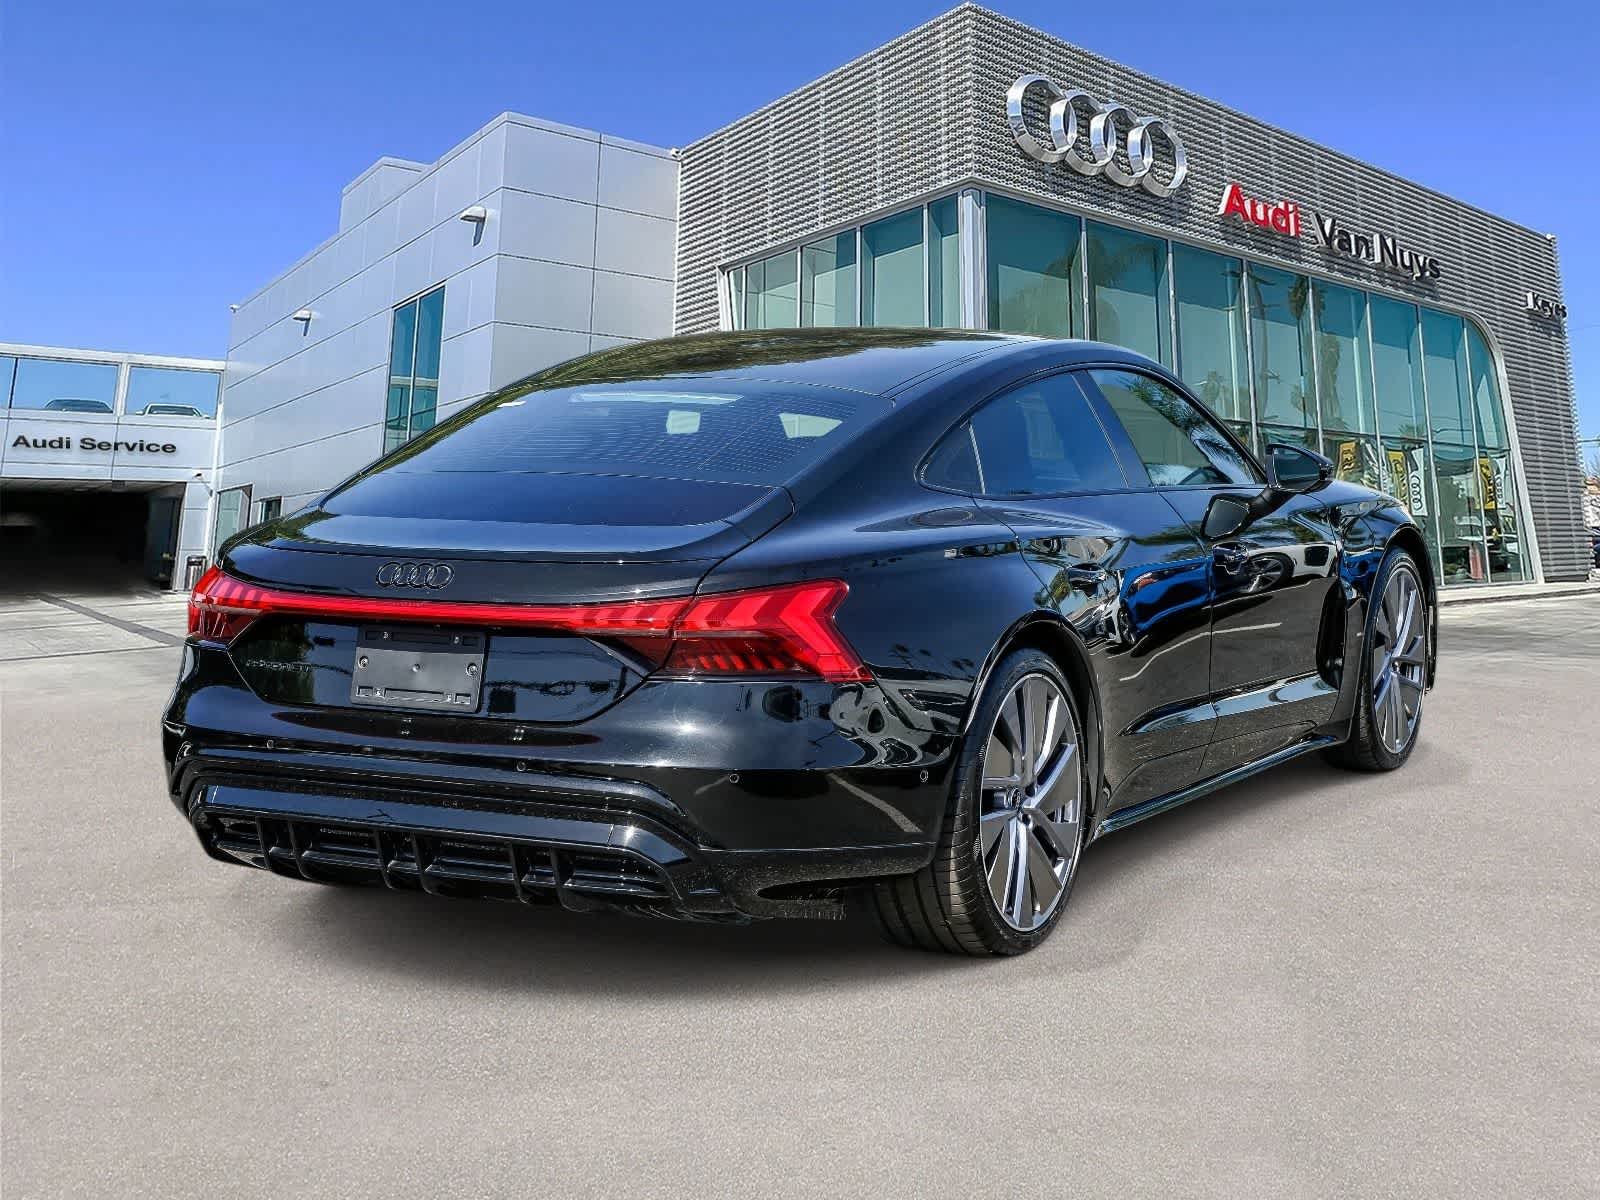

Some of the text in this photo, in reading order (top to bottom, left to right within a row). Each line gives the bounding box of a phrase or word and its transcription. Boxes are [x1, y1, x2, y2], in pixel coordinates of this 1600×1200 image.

[1217, 182, 1441, 280] Audi Van Nuys
[1526, 291, 1567, 319] Keyes
[12, 434, 177, 453] Audi Service
